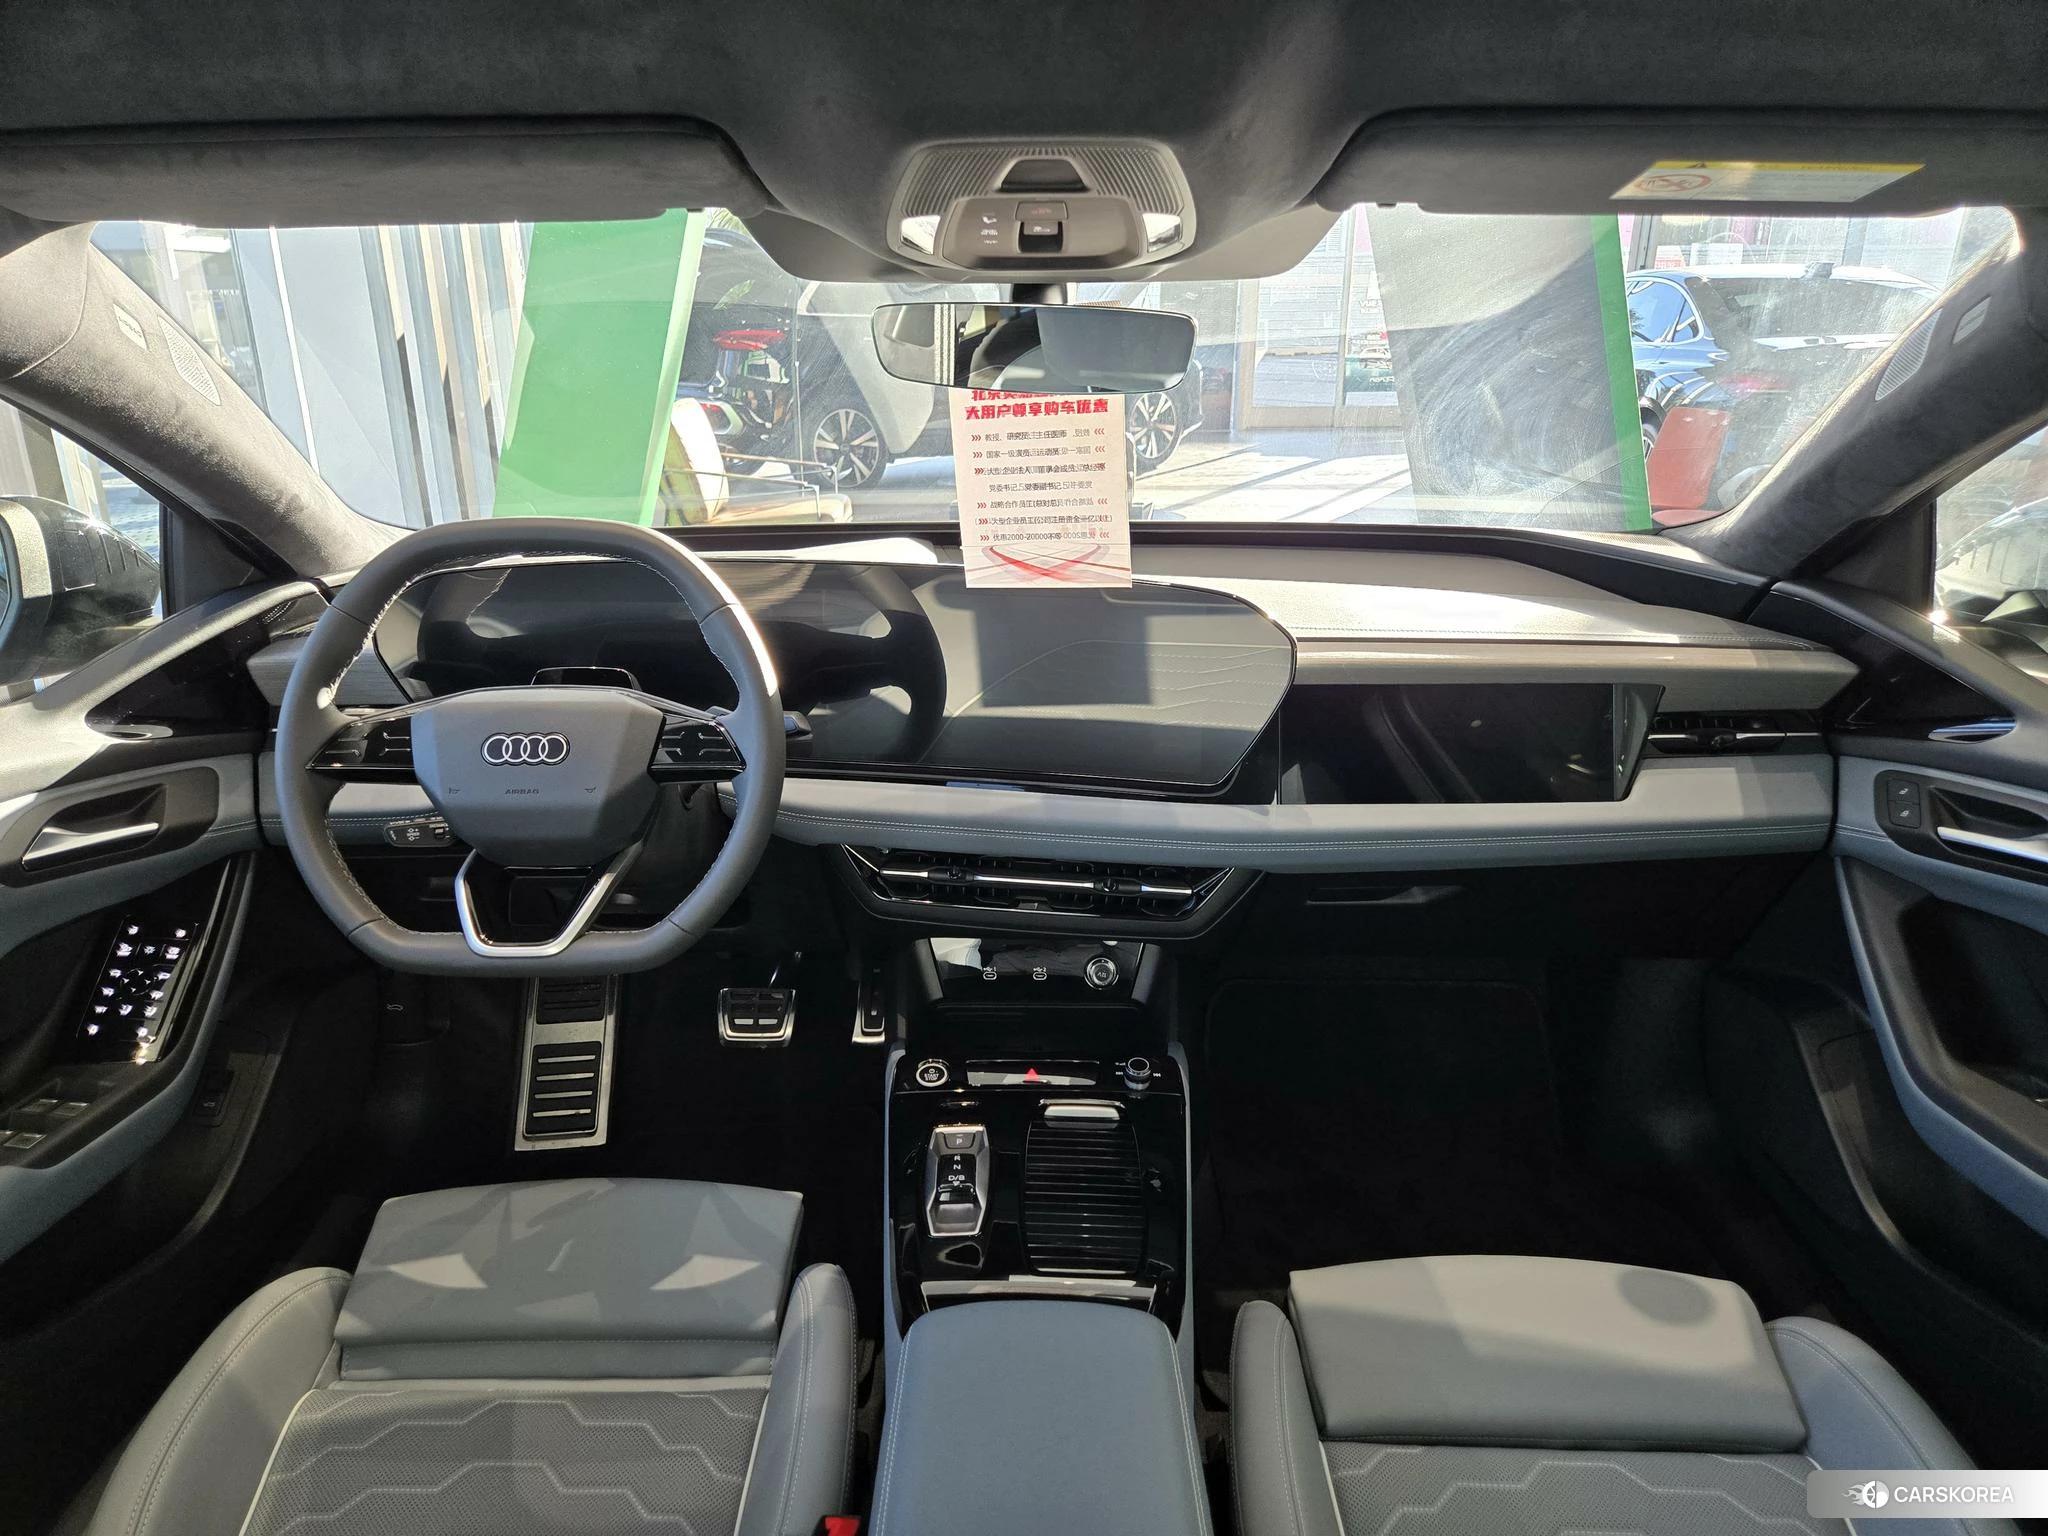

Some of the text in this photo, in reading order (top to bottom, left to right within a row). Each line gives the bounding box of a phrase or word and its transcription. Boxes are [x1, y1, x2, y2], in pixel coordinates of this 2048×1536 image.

[965, 398, 1109, 420] 大用户尊享购车优惠
